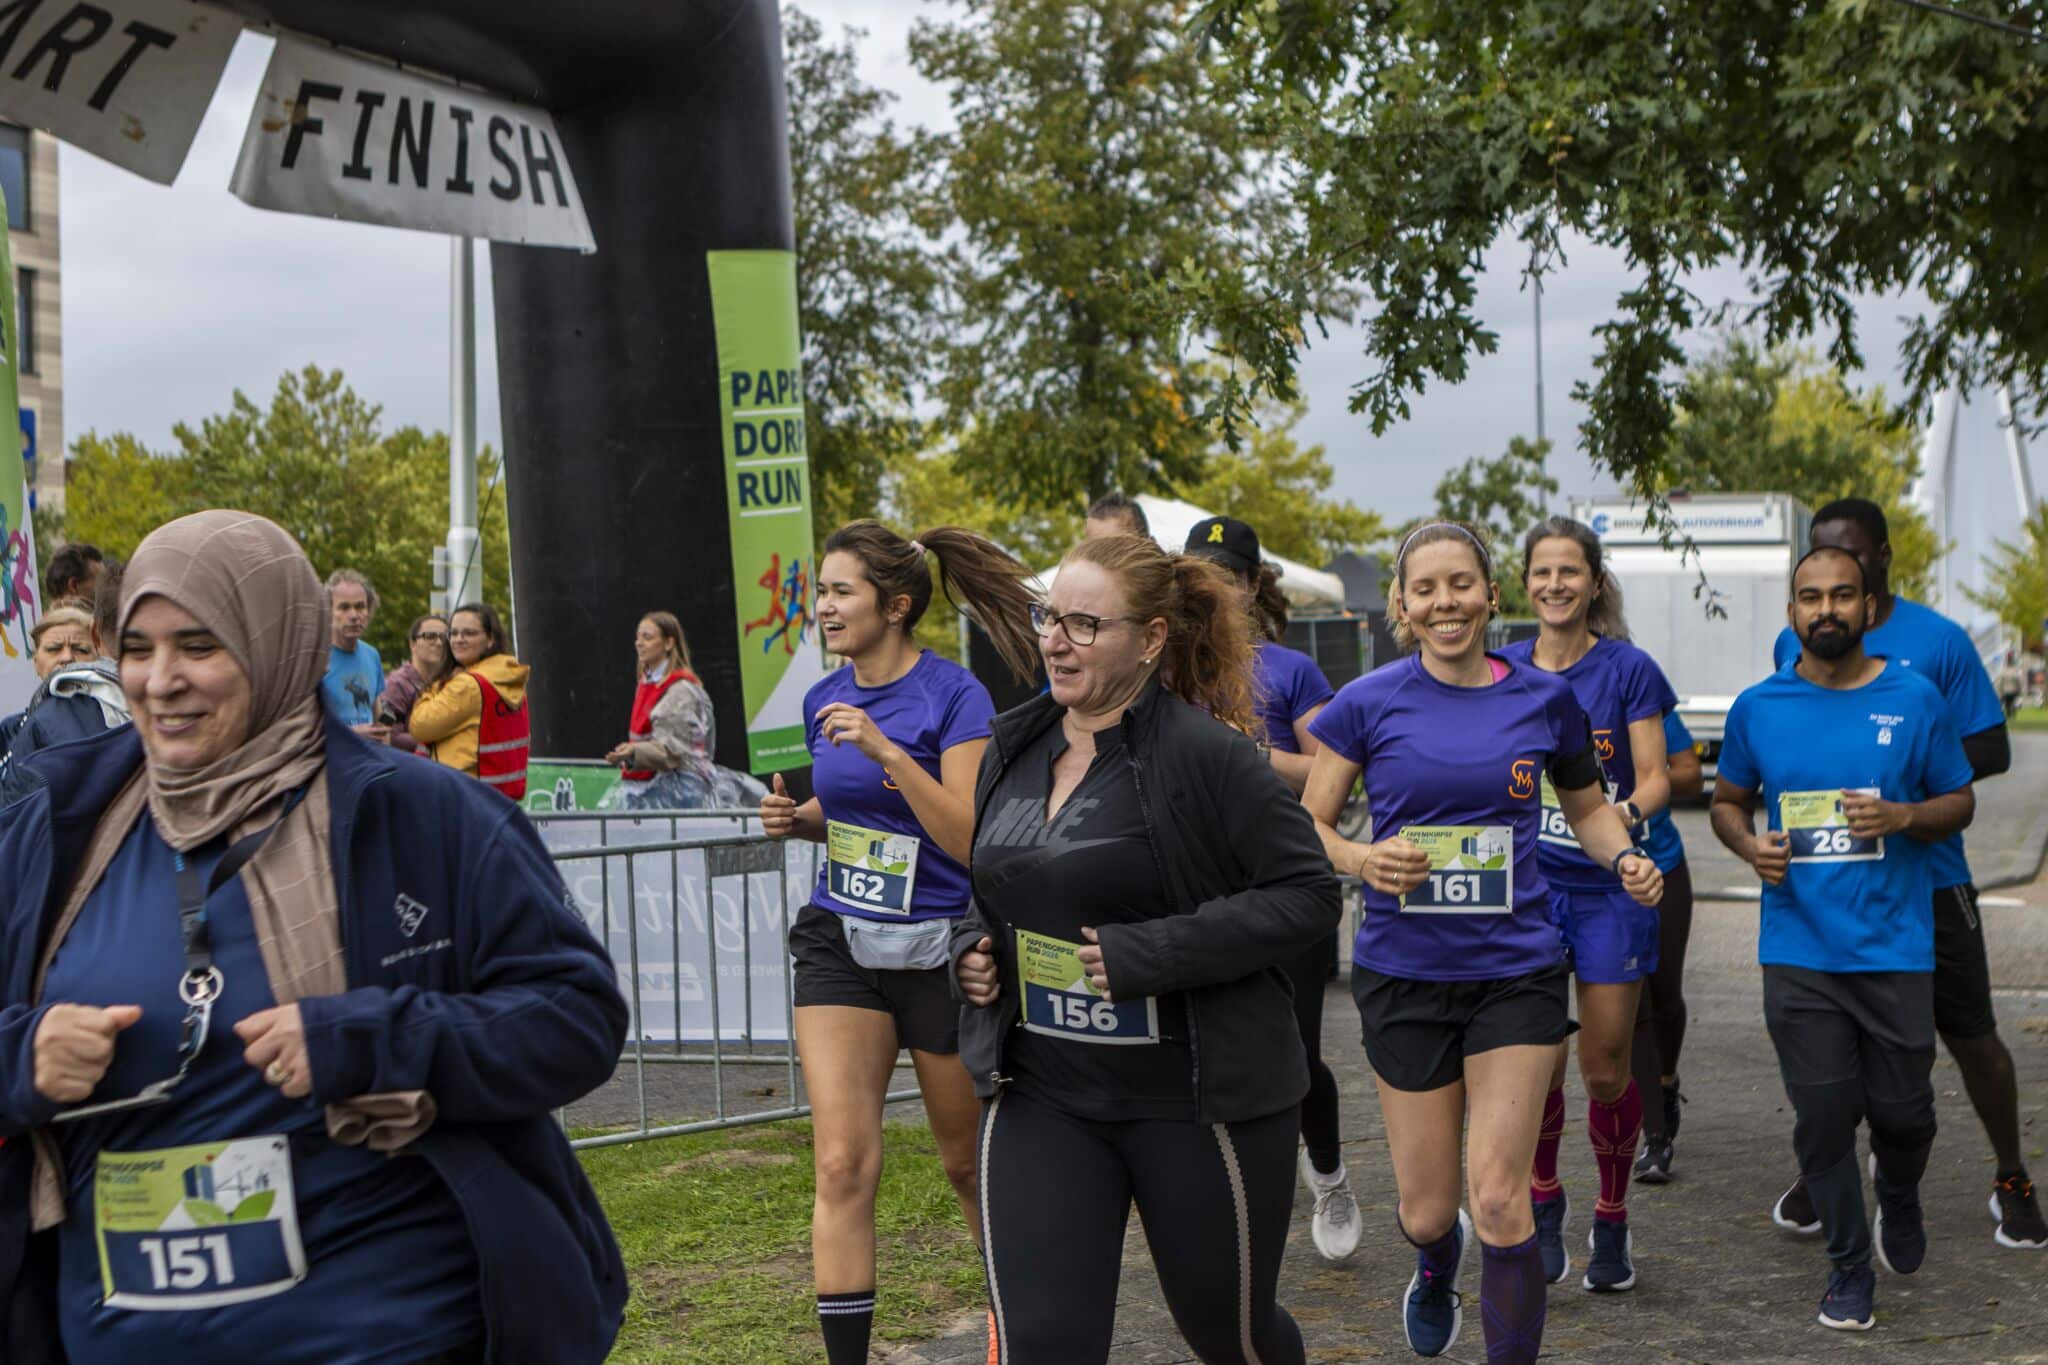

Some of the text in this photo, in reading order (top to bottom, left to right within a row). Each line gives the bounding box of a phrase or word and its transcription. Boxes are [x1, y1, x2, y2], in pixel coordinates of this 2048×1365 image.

[280, 80, 570, 209] FINISH
[737, 468, 802, 508] RUN
[1812, 829, 1851, 854] 26
[841, 868, 885, 903] 162
[1429, 874, 1480, 902] 161
[1047, 994, 1118, 1032] 156
[139, 1234, 235, 1290] 151
